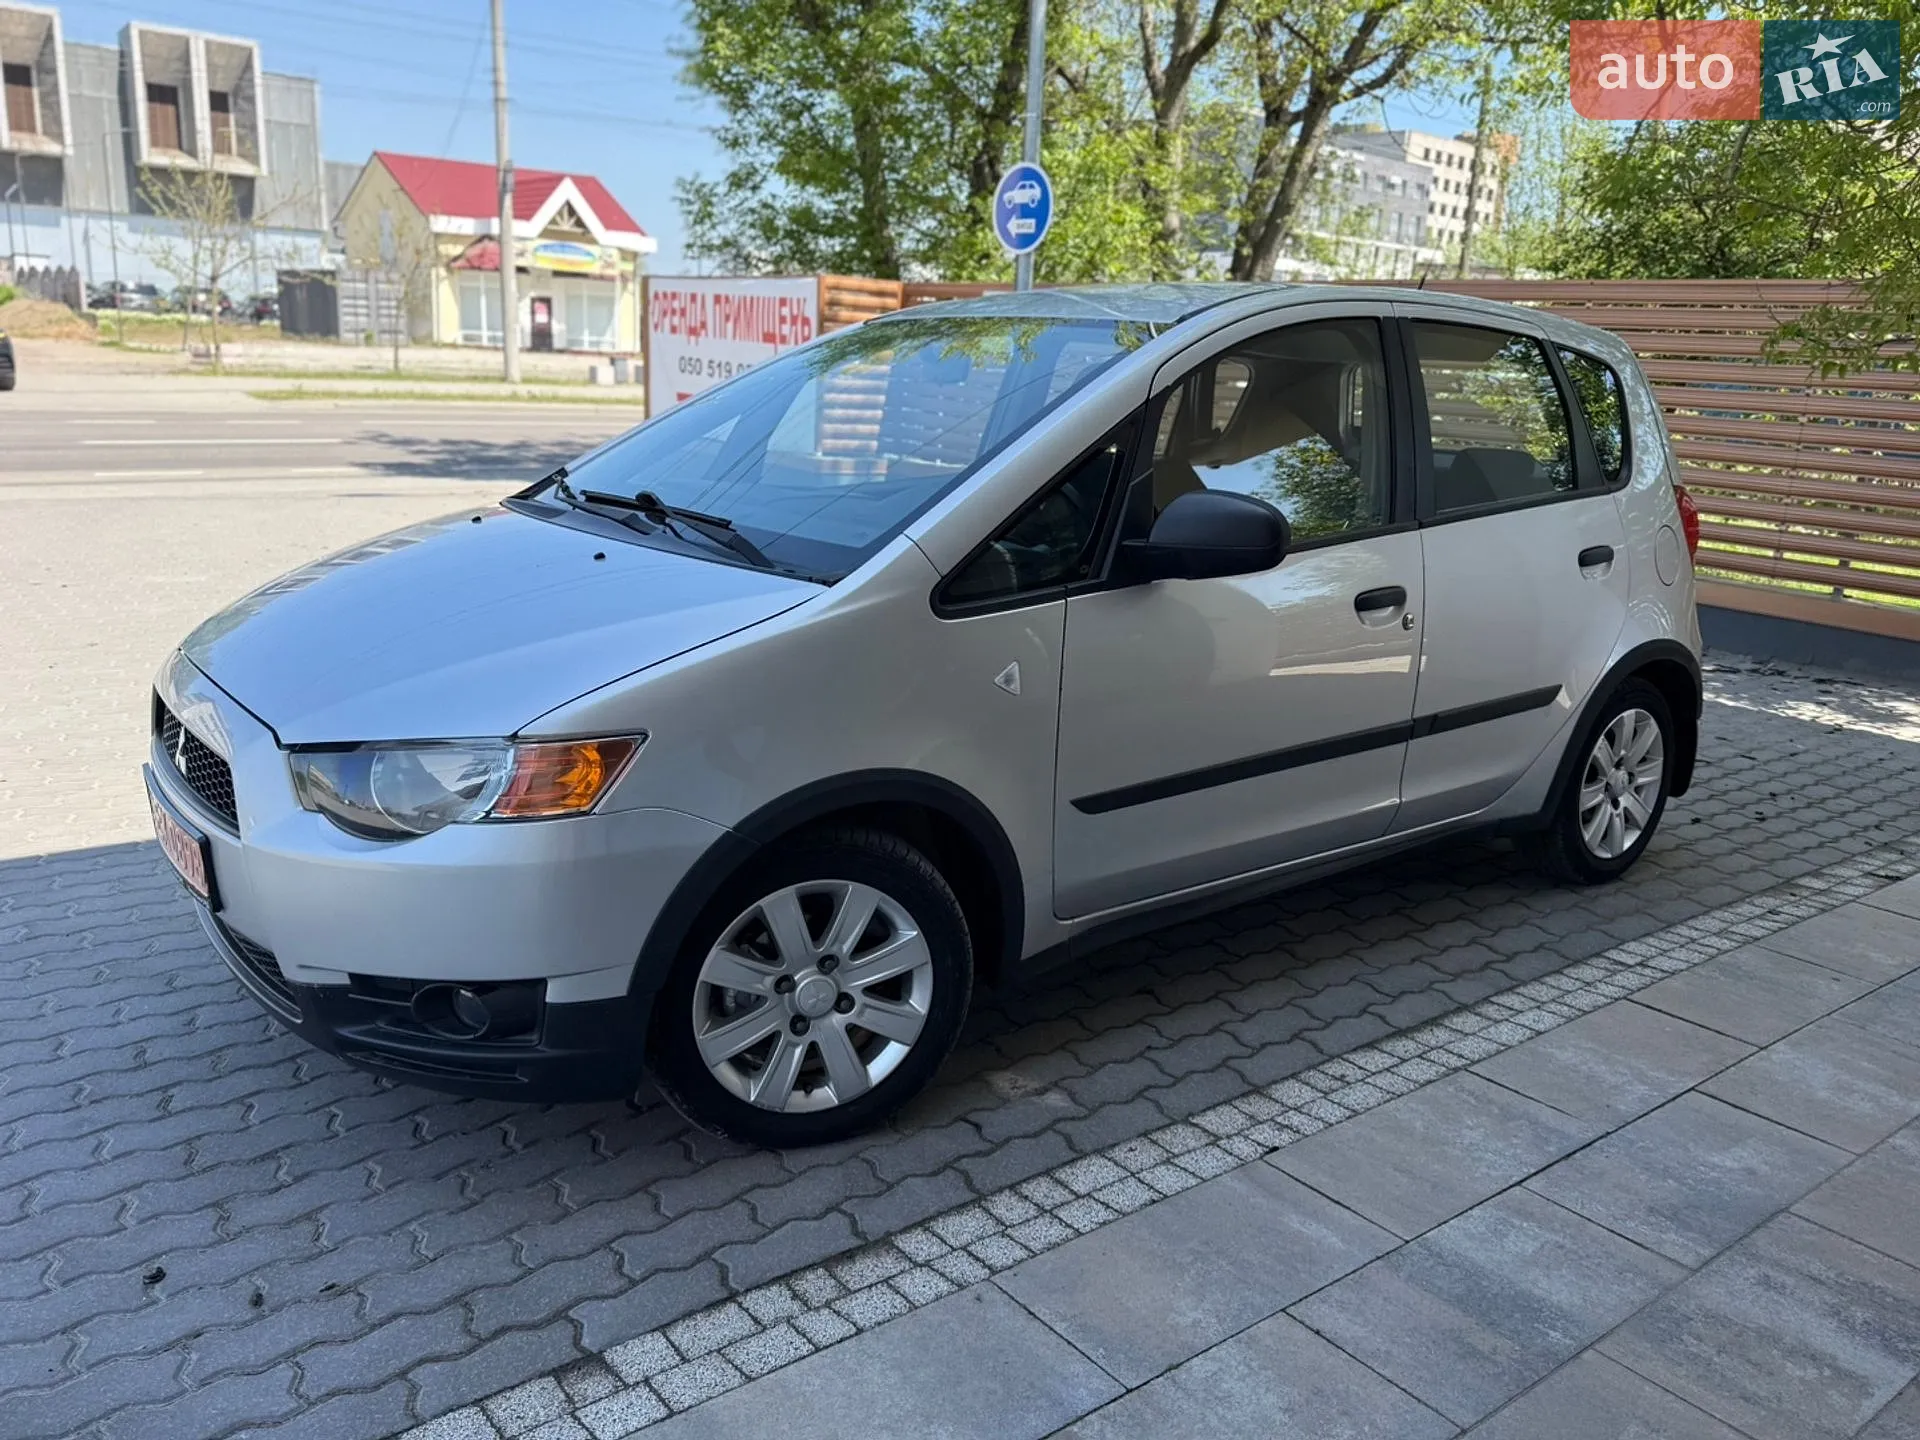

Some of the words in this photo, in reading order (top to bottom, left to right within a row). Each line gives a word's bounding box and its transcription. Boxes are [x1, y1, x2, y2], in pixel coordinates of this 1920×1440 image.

[651, 289, 708, 345] ОРЕНДА
[712, 292, 813, 353] ПРИМІЩЕНЬ
[678, 355, 703, 377] 050
[706, 358, 733, 380] 519
